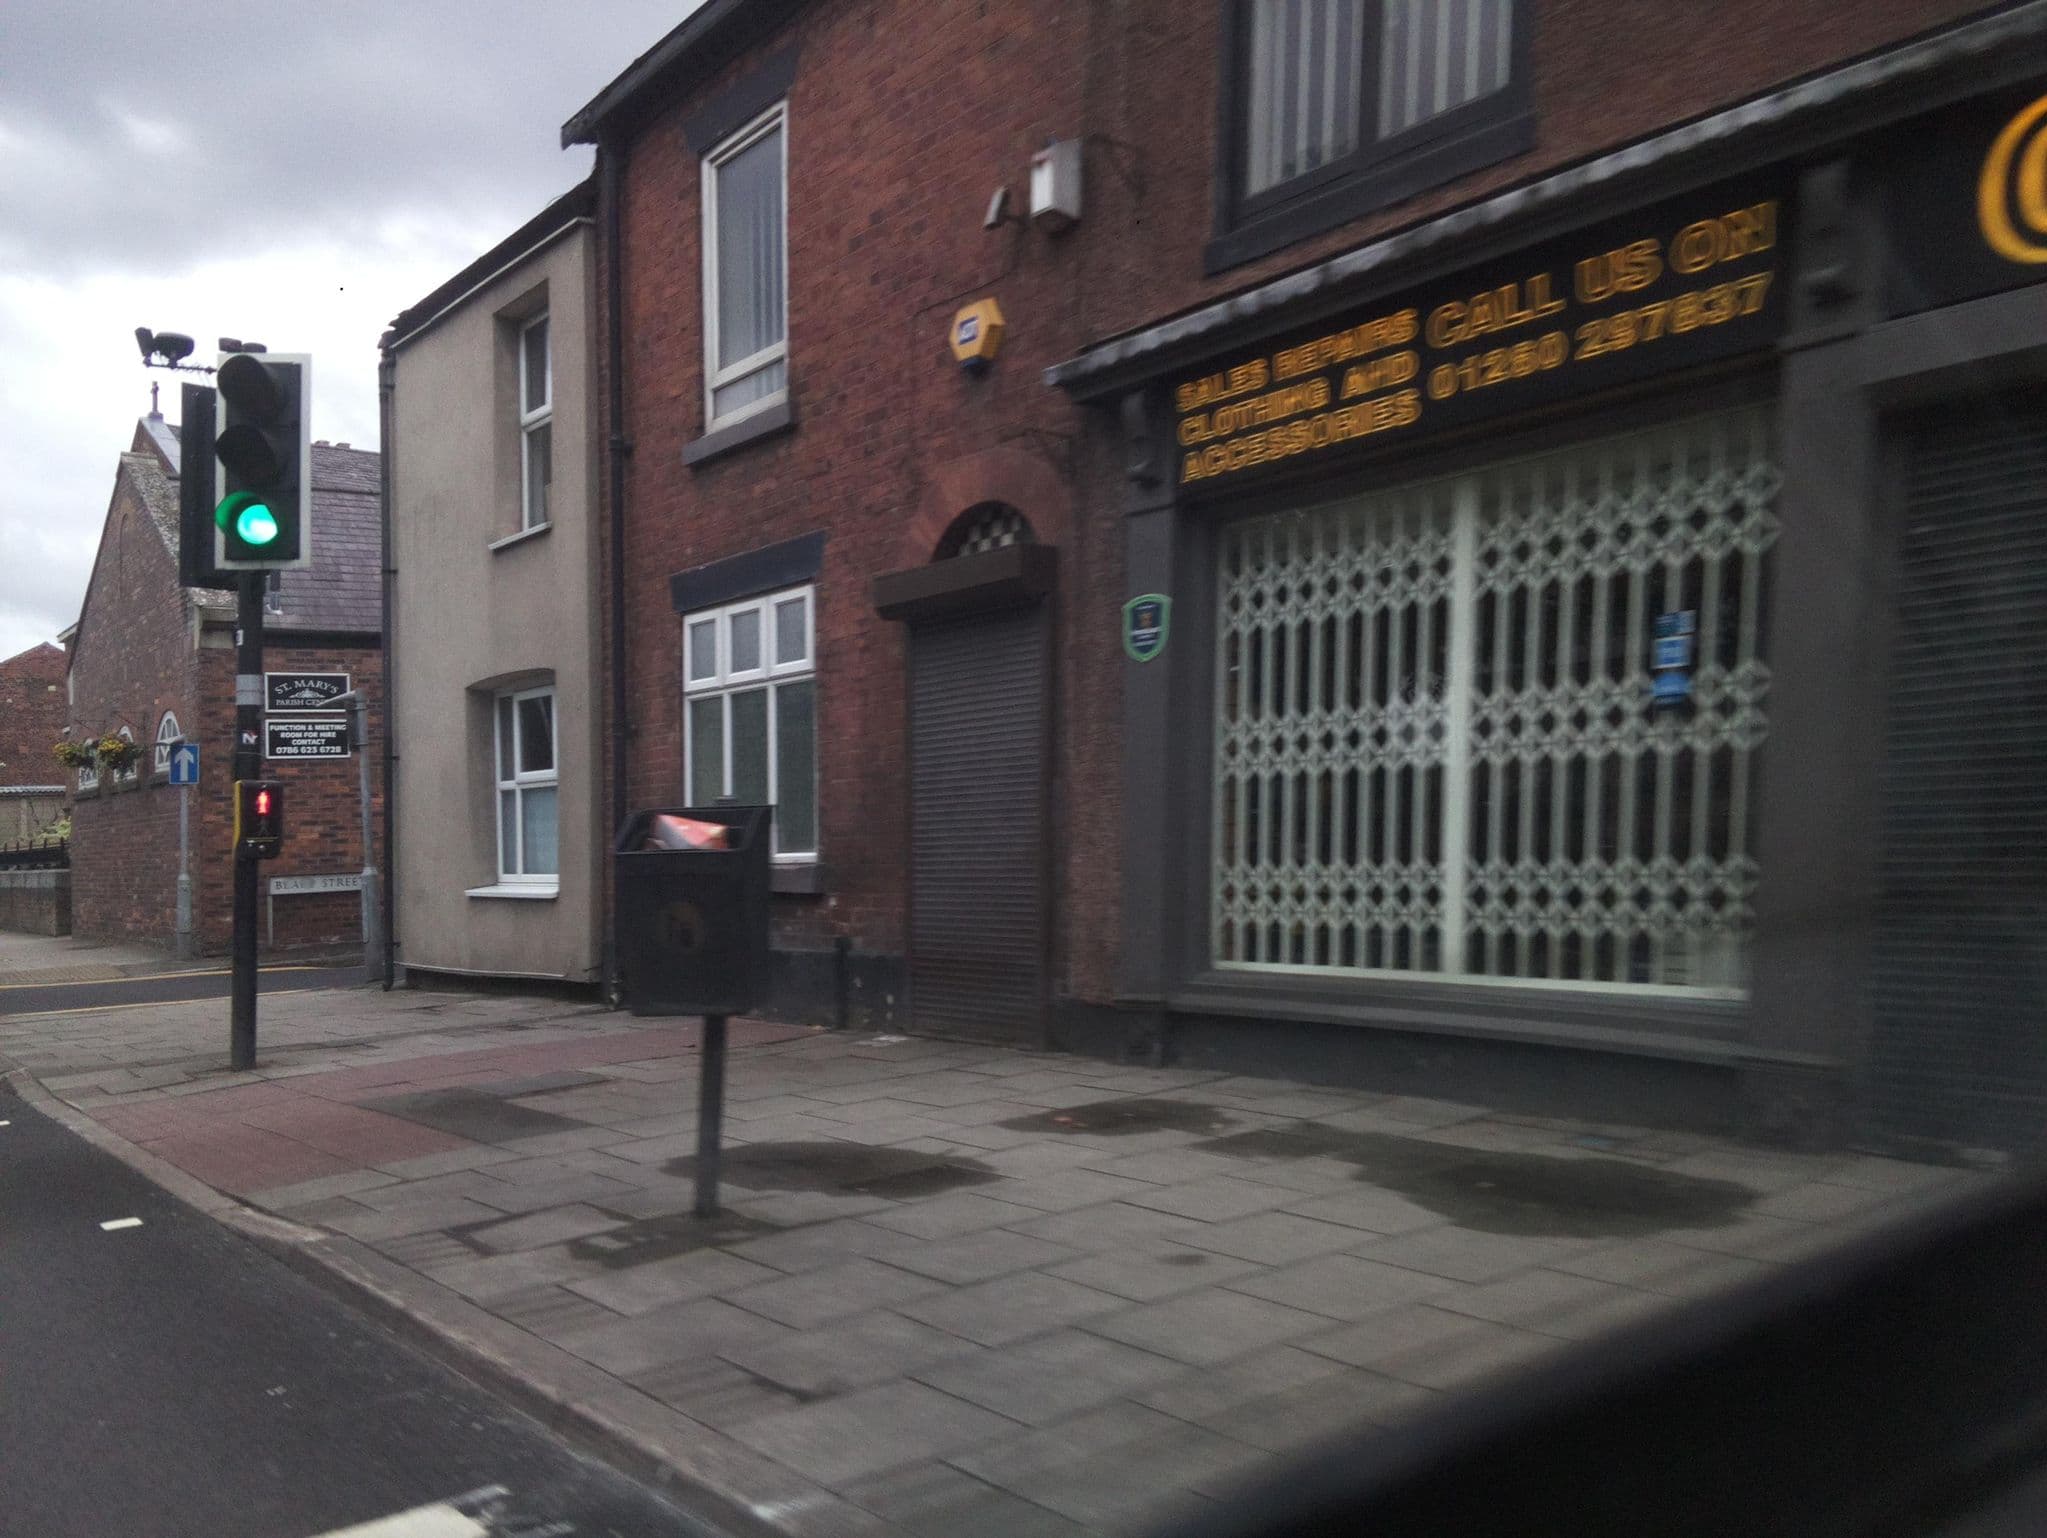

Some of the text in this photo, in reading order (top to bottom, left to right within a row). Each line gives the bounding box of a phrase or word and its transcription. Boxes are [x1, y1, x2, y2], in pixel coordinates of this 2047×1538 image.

[1426, 201, 1777, 349] CALL US ON
[1176, 308, 1420, 412] SALES REPAIRS
[1177, 350, 1420, 446] CLOTHING AND
[1179, 388, 1422, 484] ACCESSORIES
[275, 680, 339, 694] ST. MARY'S
